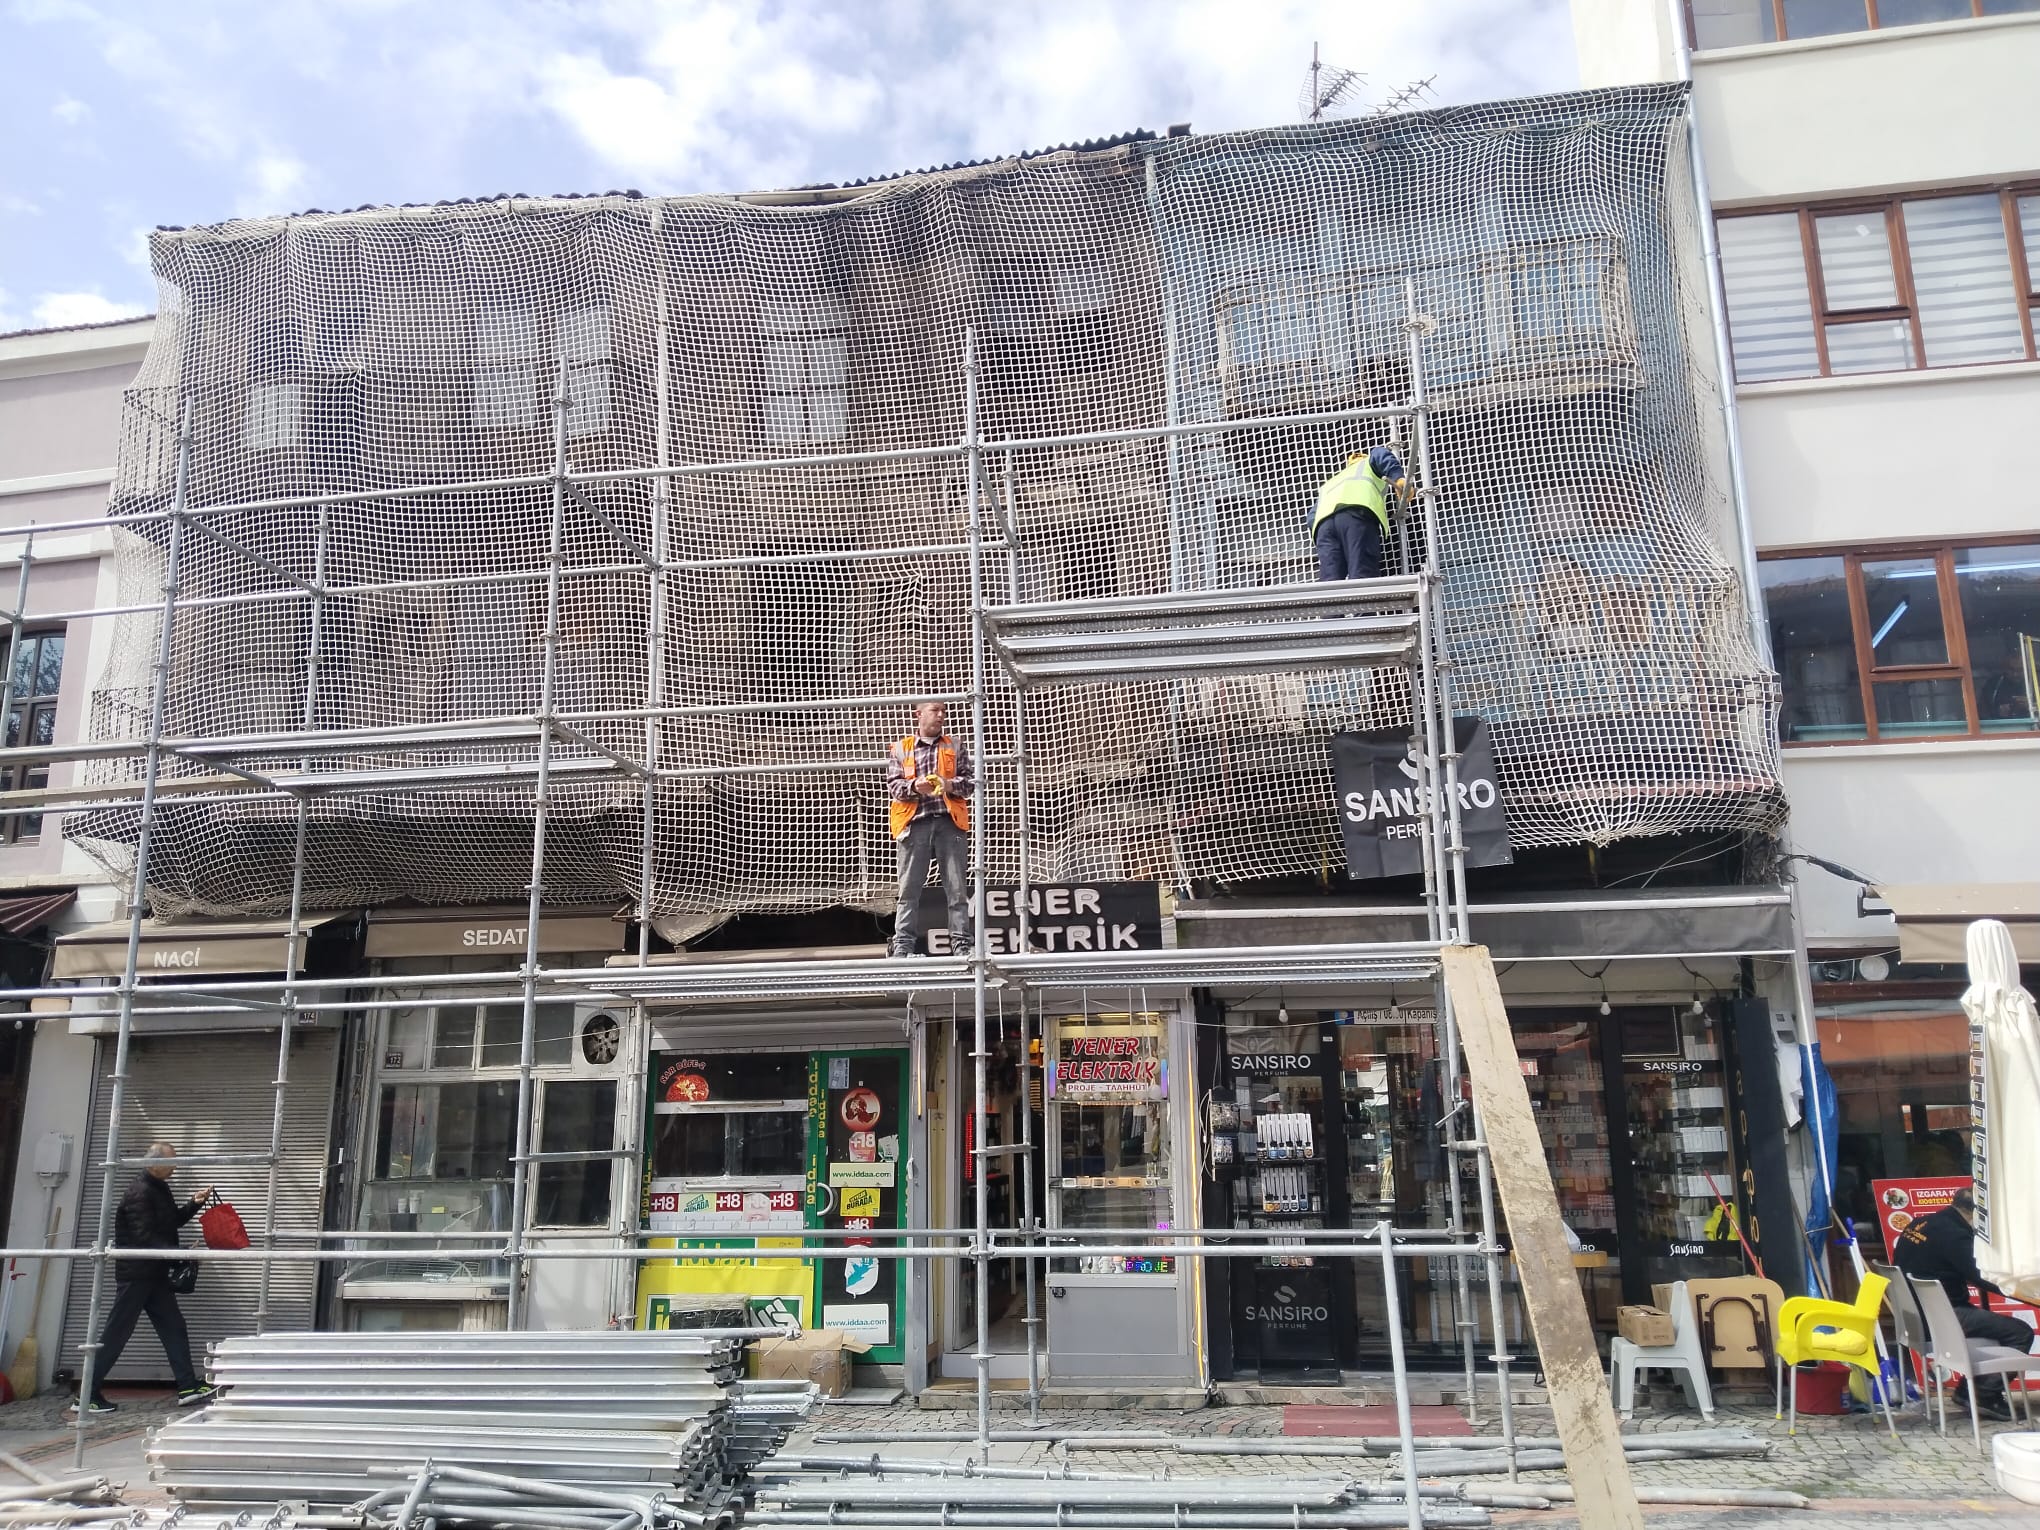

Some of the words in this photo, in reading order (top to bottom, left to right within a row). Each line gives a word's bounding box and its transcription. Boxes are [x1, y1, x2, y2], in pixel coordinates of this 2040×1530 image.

[462, 928, 528, 946] SEDAT
[927, 917, 1139, 955] EEKTRİK
[153, 947, 201, 968] NACİ
[1072, 1037, 1140, 1056] YENER
[1056, 1057, 1156, 1080] ELEKTRİK
[818, 1089, 827, 1138] iddaa
[651, 1196, 676, 1211] +18
[716, 1193, 741, 1208] +18
[771, 1192, 794, 1207] +18
[825, 1319, 887, 1327] www.iddaa.com
